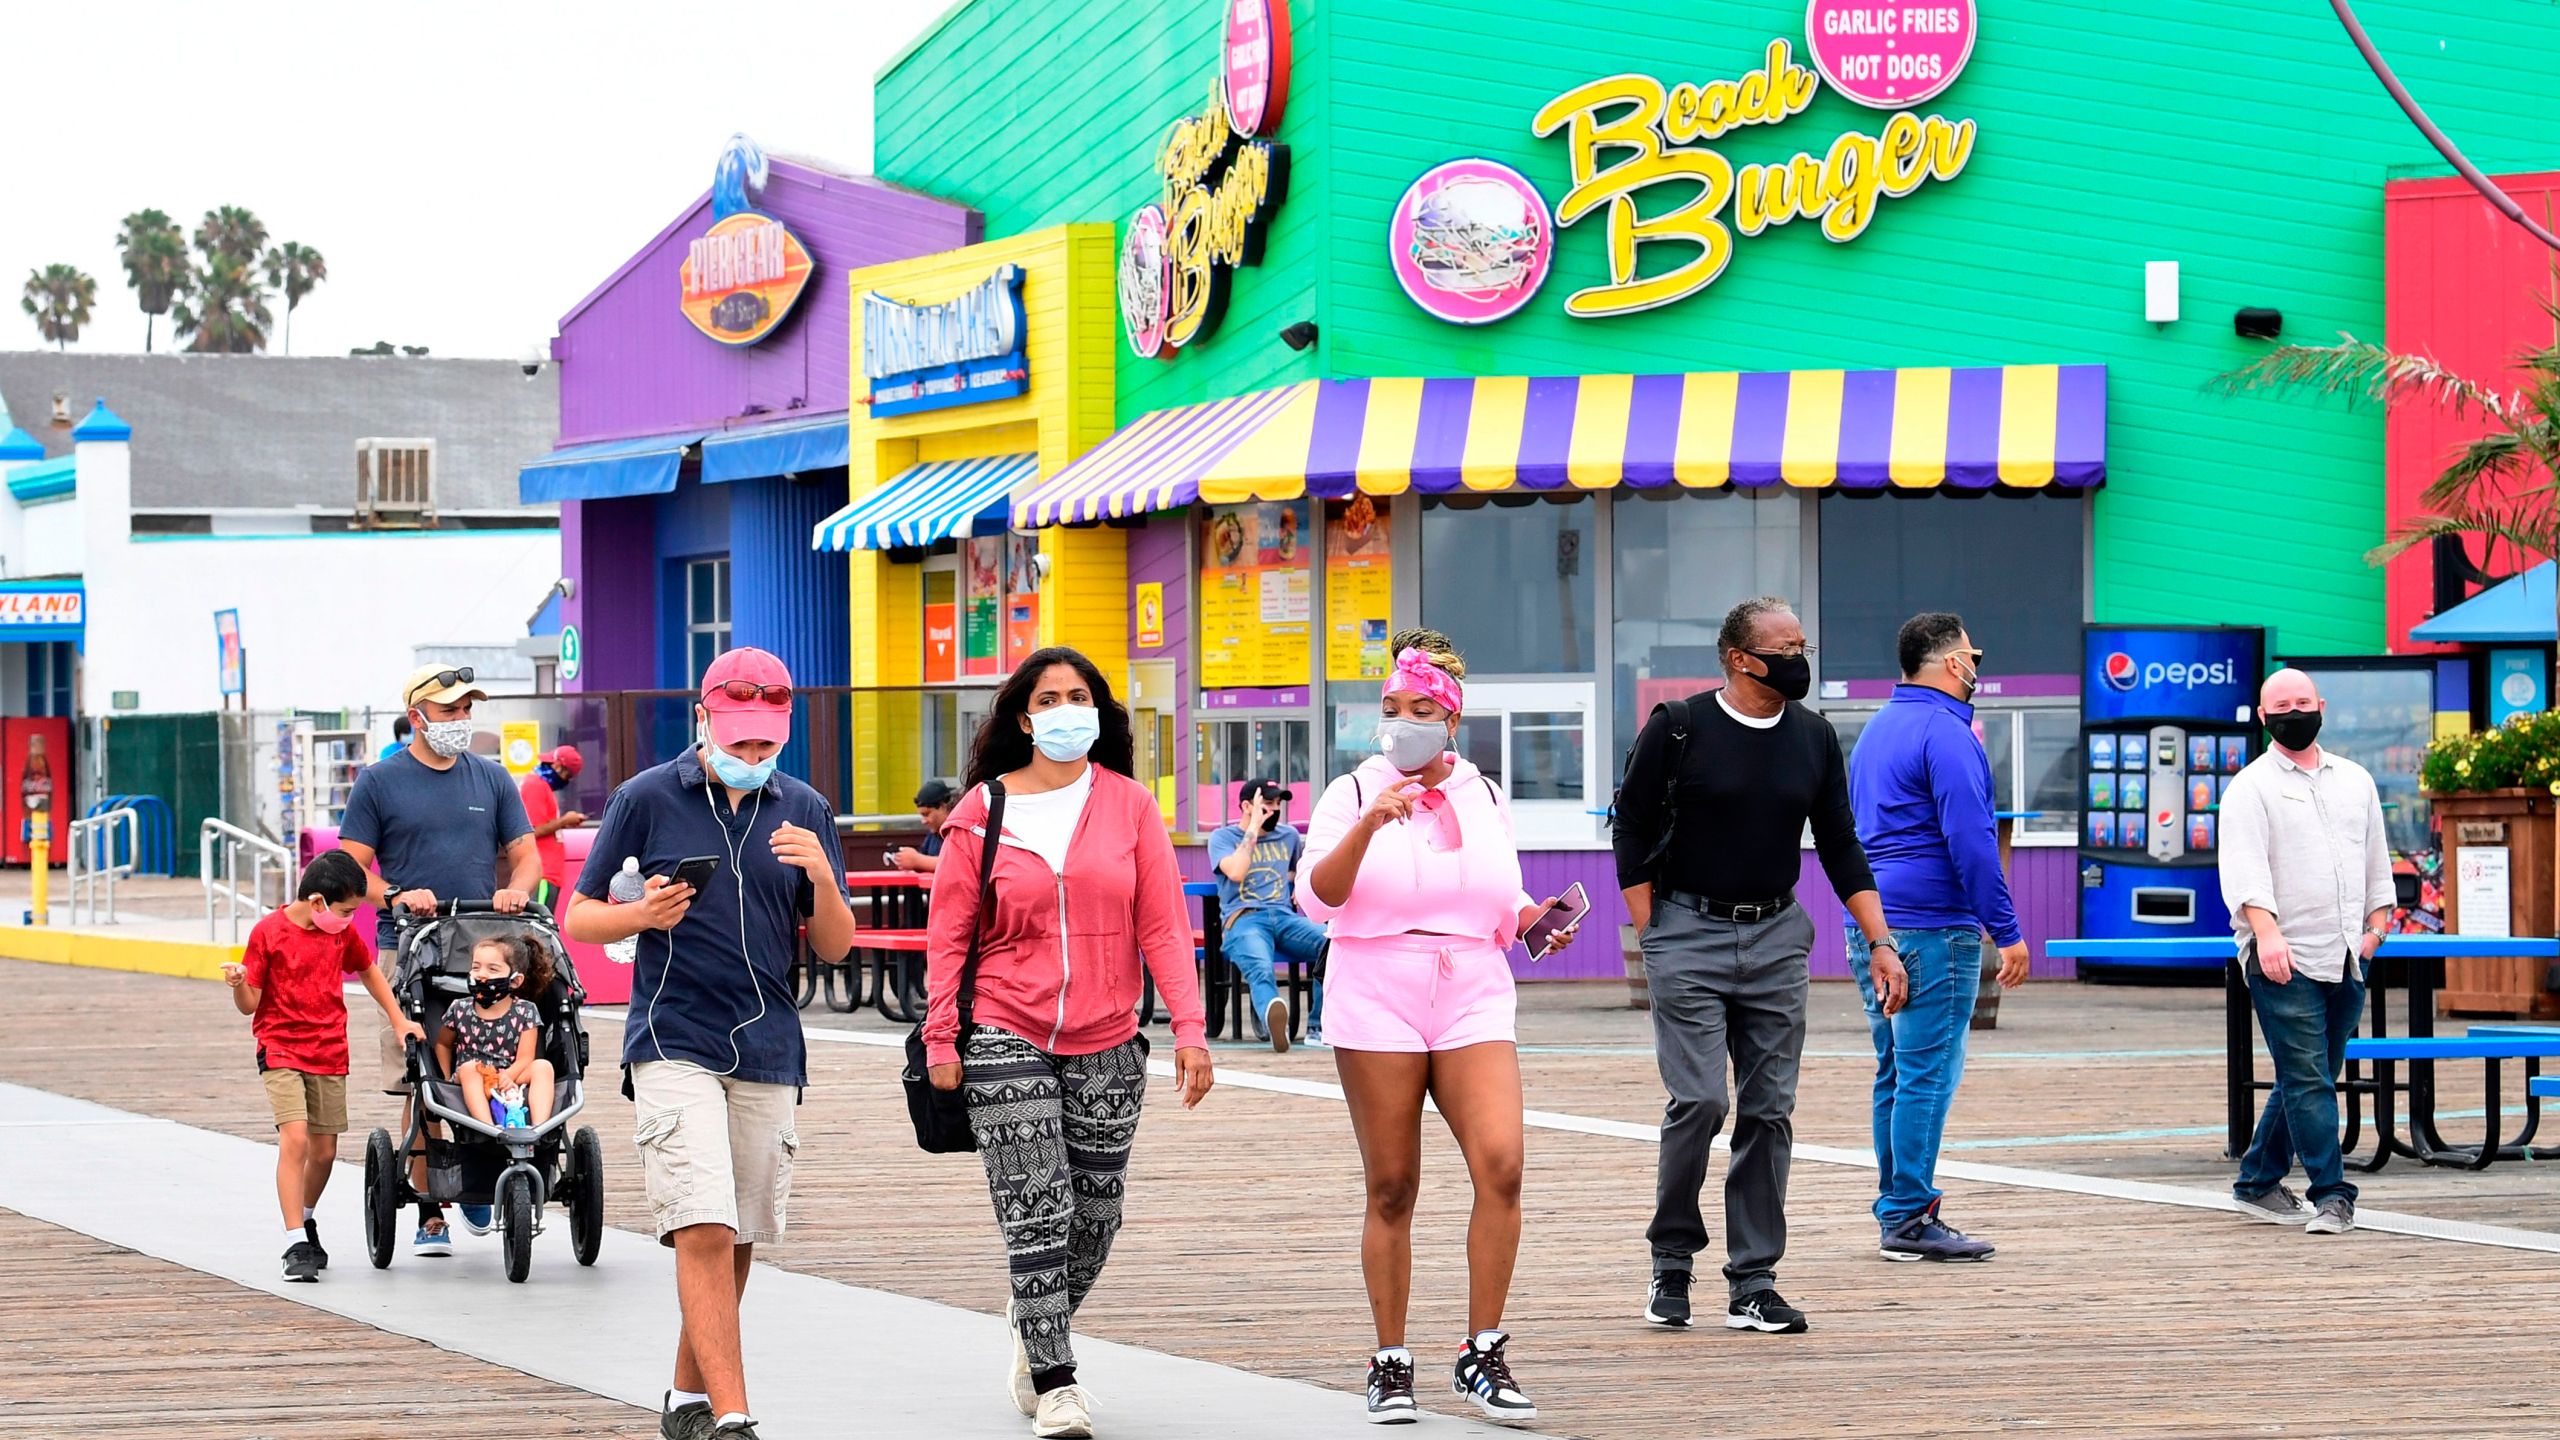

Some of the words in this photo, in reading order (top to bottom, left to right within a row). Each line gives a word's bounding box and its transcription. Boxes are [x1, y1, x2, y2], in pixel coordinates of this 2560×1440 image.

[1824, 9, 1897, 35] GARLIC
[1903, 8, 1960, 34] FRIES
[1841, 55, 1881, 80] HOT
[1887, 54, 1942, 80] DOGS
[1532, 38, 1820, 212] Beach
[1557, 110, 1977, 318] Burger
[2145, 657, 2234, 690] pepsi
